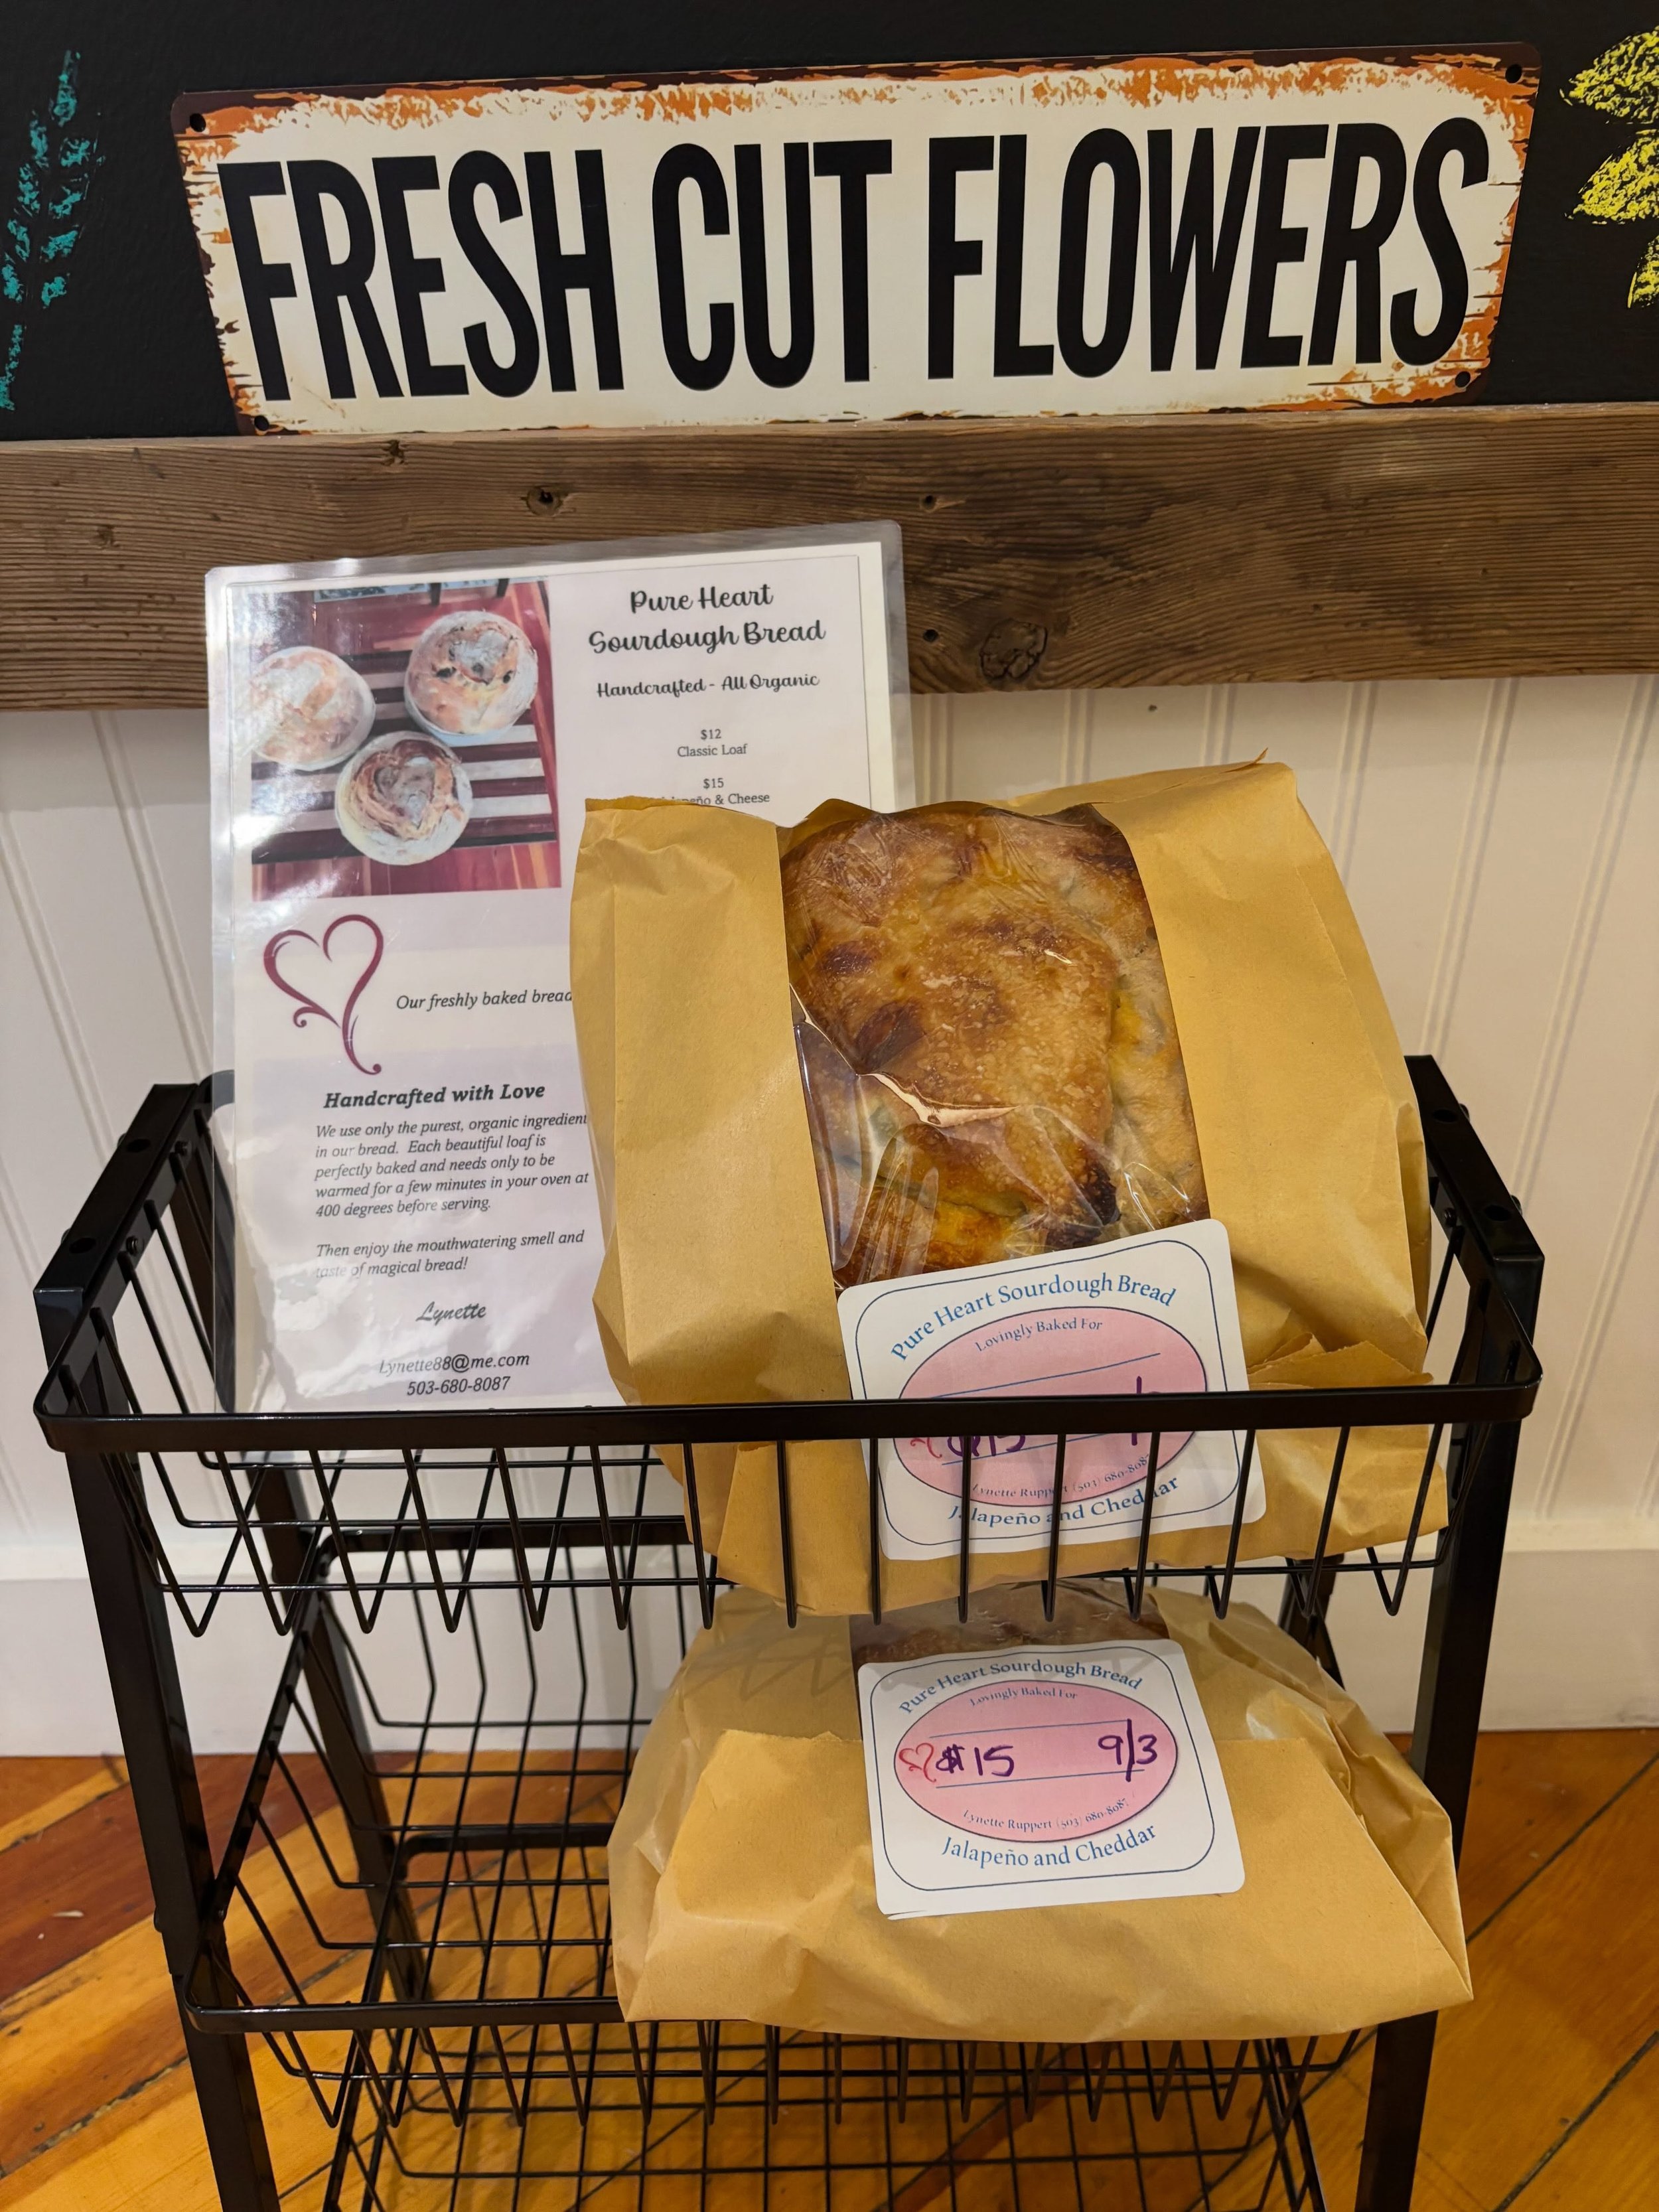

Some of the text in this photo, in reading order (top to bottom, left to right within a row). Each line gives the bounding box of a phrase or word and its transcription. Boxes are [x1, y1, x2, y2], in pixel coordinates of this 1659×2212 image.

[217, 117, 1488, 400] FRESH CUT FLOWERS
[630, 583, 773, 614] Pure Heart
[589, 619, 826, 654] Sourdough Bread
[597, 678, 707, 698] Handcrafted
[721, 675, 747, 692] All
[749, 673, 820, 693] Organic
[700, 728, 722, 741] $12
[677, 743, 748, 757] Classic Loaf
[703, 778, 724, 789] $15
[715, 794, 725, 805] &
[728, 793, 770, 804] Cheese
[396, 995, 426, 1009] Our
[427, 992, 478, 1011] freshly
[482, 990, 528, 1005] baked
[323, 1082, 545, 1109] Handcrafted with Love
[316, 1125, 336, 1138] We
[340, 1126, 361, 1136] use
[365, 1122, 394, 1138] only
[397, 1121, 417, 1134] the
[420, 1120, 464, 1136] purest,
[469, 1116, 519, 1133] organic
[316, 1134, 546, 1157] in our bread. Each beautiful loaf is
[315, 1153, 555, 1181] perfectly baked and needs only to be
[315, 1171, 589, 1201] warmed for a few minutes in your oven at
[315, 1196, 491, 1218] 400 degrees before serving.
[317, 1229, 585, 1258] Then enjoy the mouthwatering smell and
[316, 1257, 469, 1280] taste of magical bread!
[415, 1301, 486, 1325] Lynette
[891, 1272, 1177, 1362] Pure Heart Sourdough Bread
[975, 1317, 1103, 1351] Lovingly Baked For
[379, 1353, 530, 1374] Lynette88@me.com
[407, 1375, 511, 1396] 503-680-8087
[1020, 1485, 1068, 1499] Ruppt
[948, 1506, 1041, 1528] Jlapeño
[899, 1659, 1143, 1714] Pure Heart Sourdough Bread
[970, 1687, 1078, 1707] Lovingly Baked For
[936, 1718, 1157, 1782] $15 9/3
[964, 1809, 1004, 1828] Lynette
[1007, 1819, 1052, 1833] Ruppert
[1056, 1816, 1082, 1830] (503)
[942, 1825, 1157, 1869] Jalapeño and Cheddar
